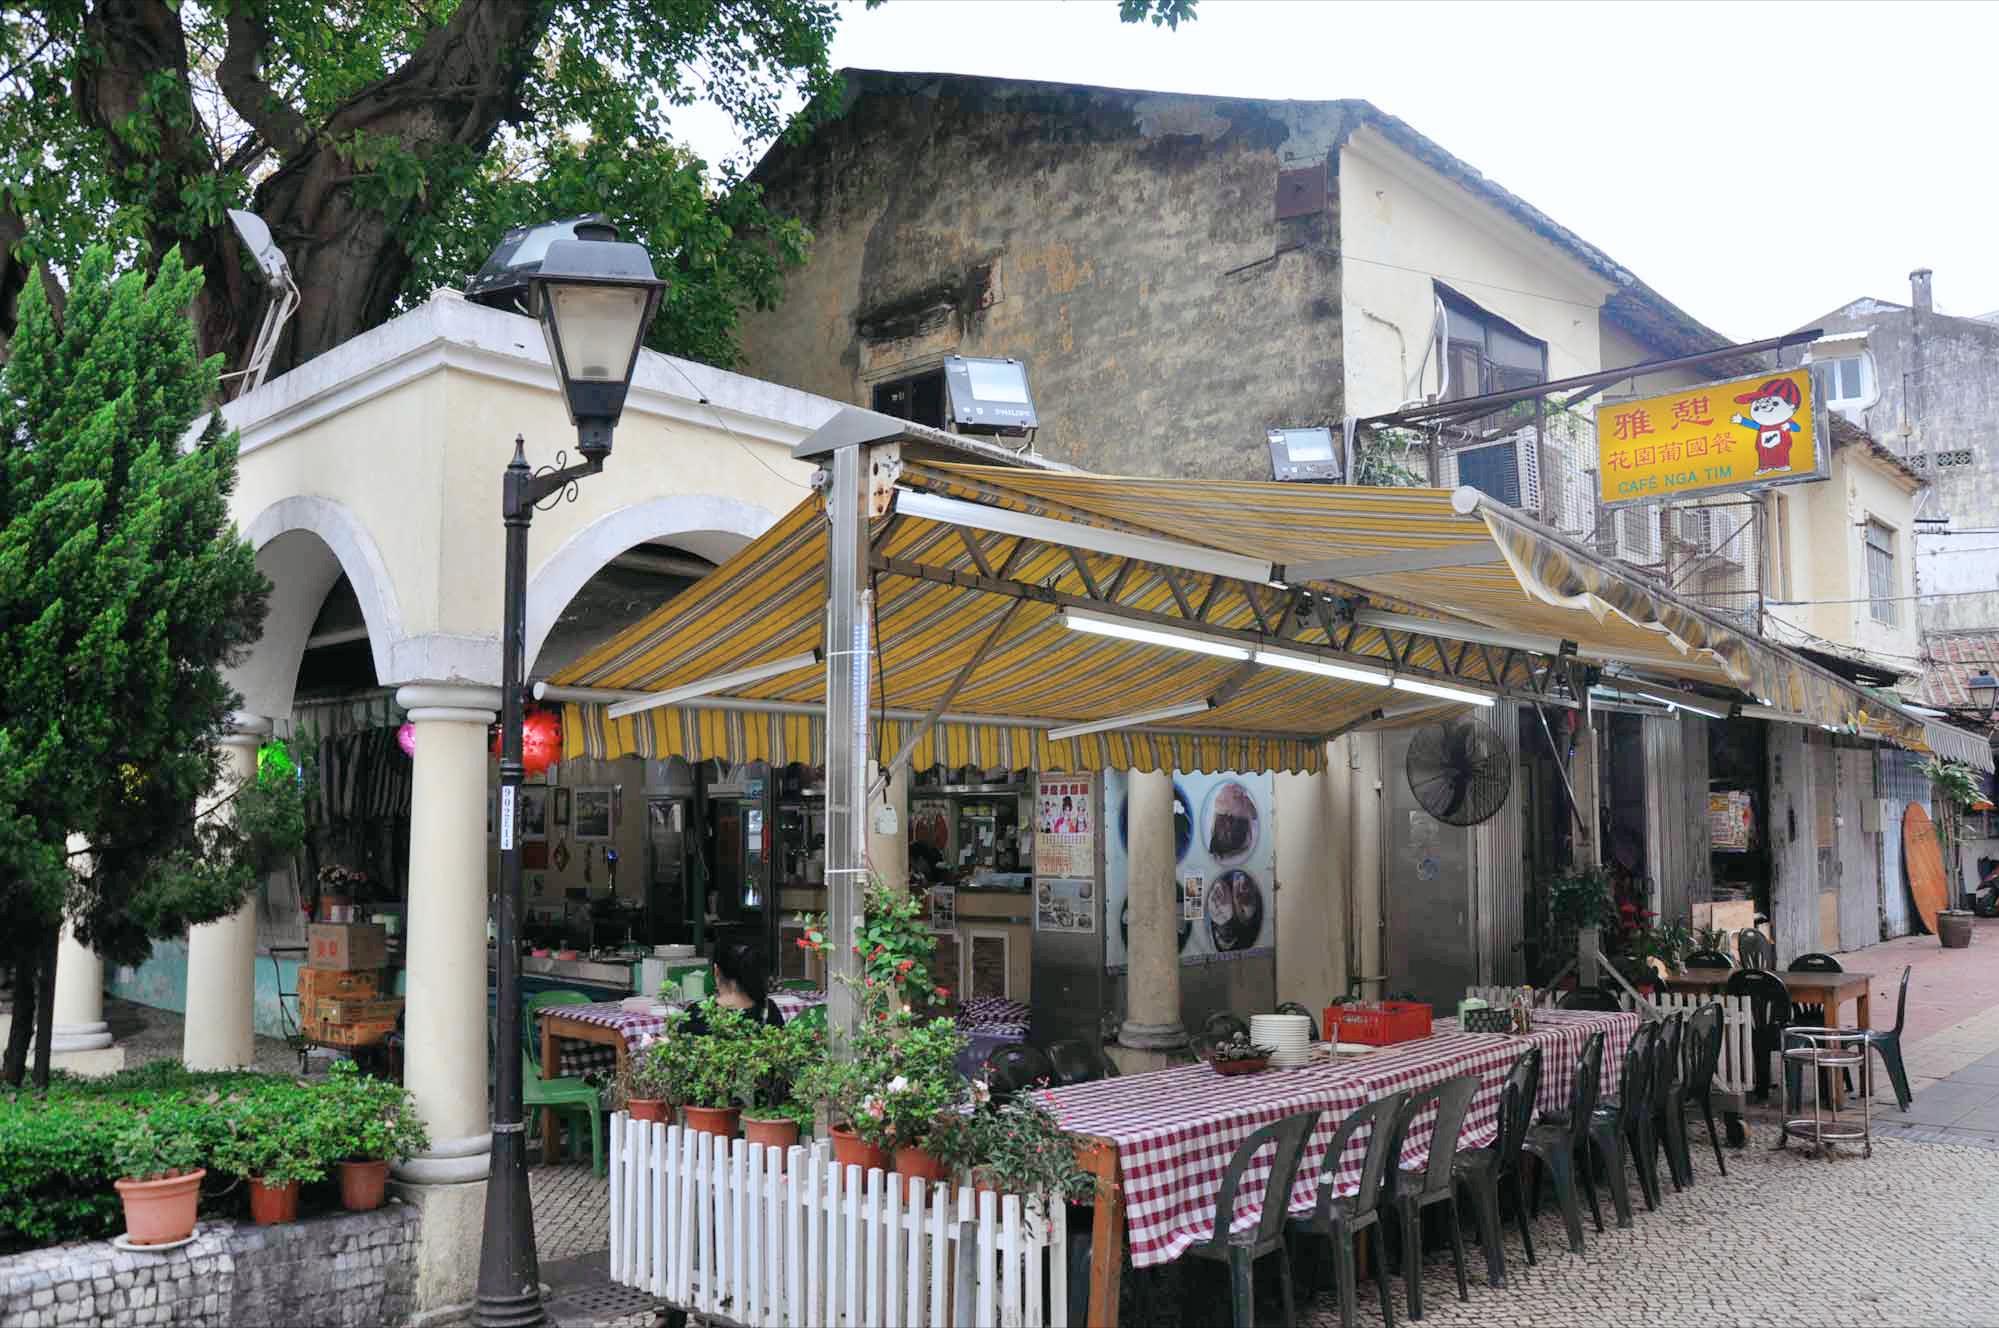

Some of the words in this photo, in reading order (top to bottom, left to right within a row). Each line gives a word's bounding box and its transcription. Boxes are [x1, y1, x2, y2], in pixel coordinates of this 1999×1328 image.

[994, 407, 1031, 417] PHILIPS
[1607, 432, 1737, 473] 花園葡國餐
[1618, 474, 1658, 495] CAFÉ
[1664, 471, 1698, 487] NGA
[1704, 465, 1733, 481] TIM
